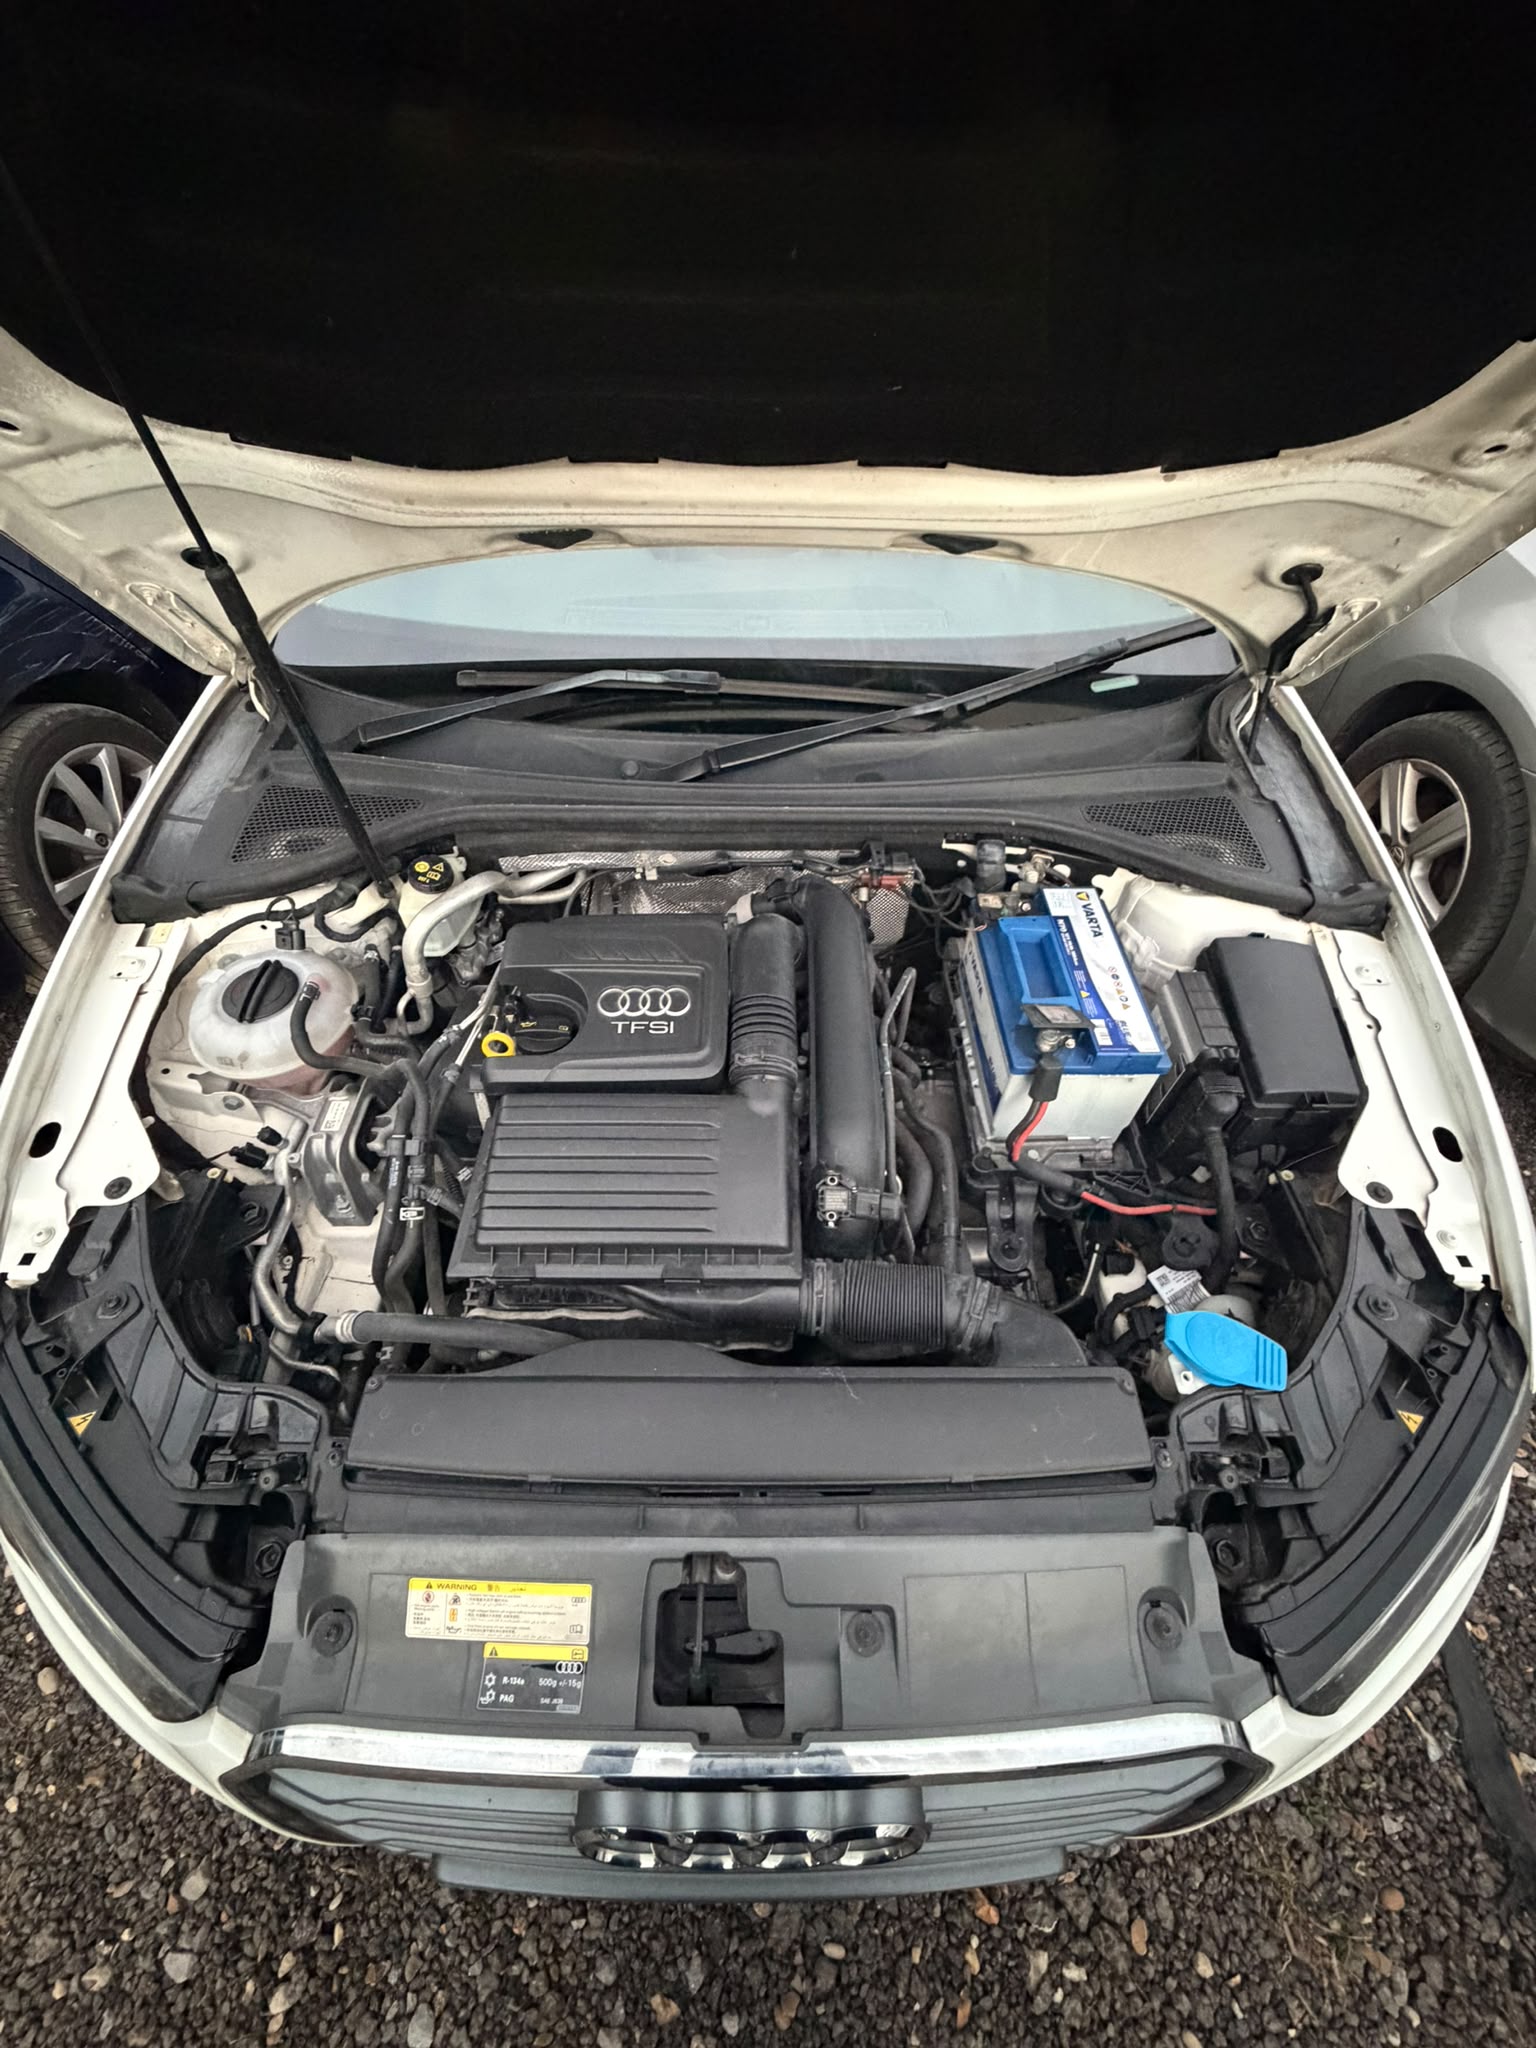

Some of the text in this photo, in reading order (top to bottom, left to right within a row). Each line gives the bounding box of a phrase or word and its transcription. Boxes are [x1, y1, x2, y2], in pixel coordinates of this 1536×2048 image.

[1081, 903, 1103, 938] VARTA
[610, 1021, 674, 1034] TFSI
[436, 1583, 478, 1592] WARNING
[538, 1677, 557, 1689] 500g
[499, 1694, 515, 1703] PAG
